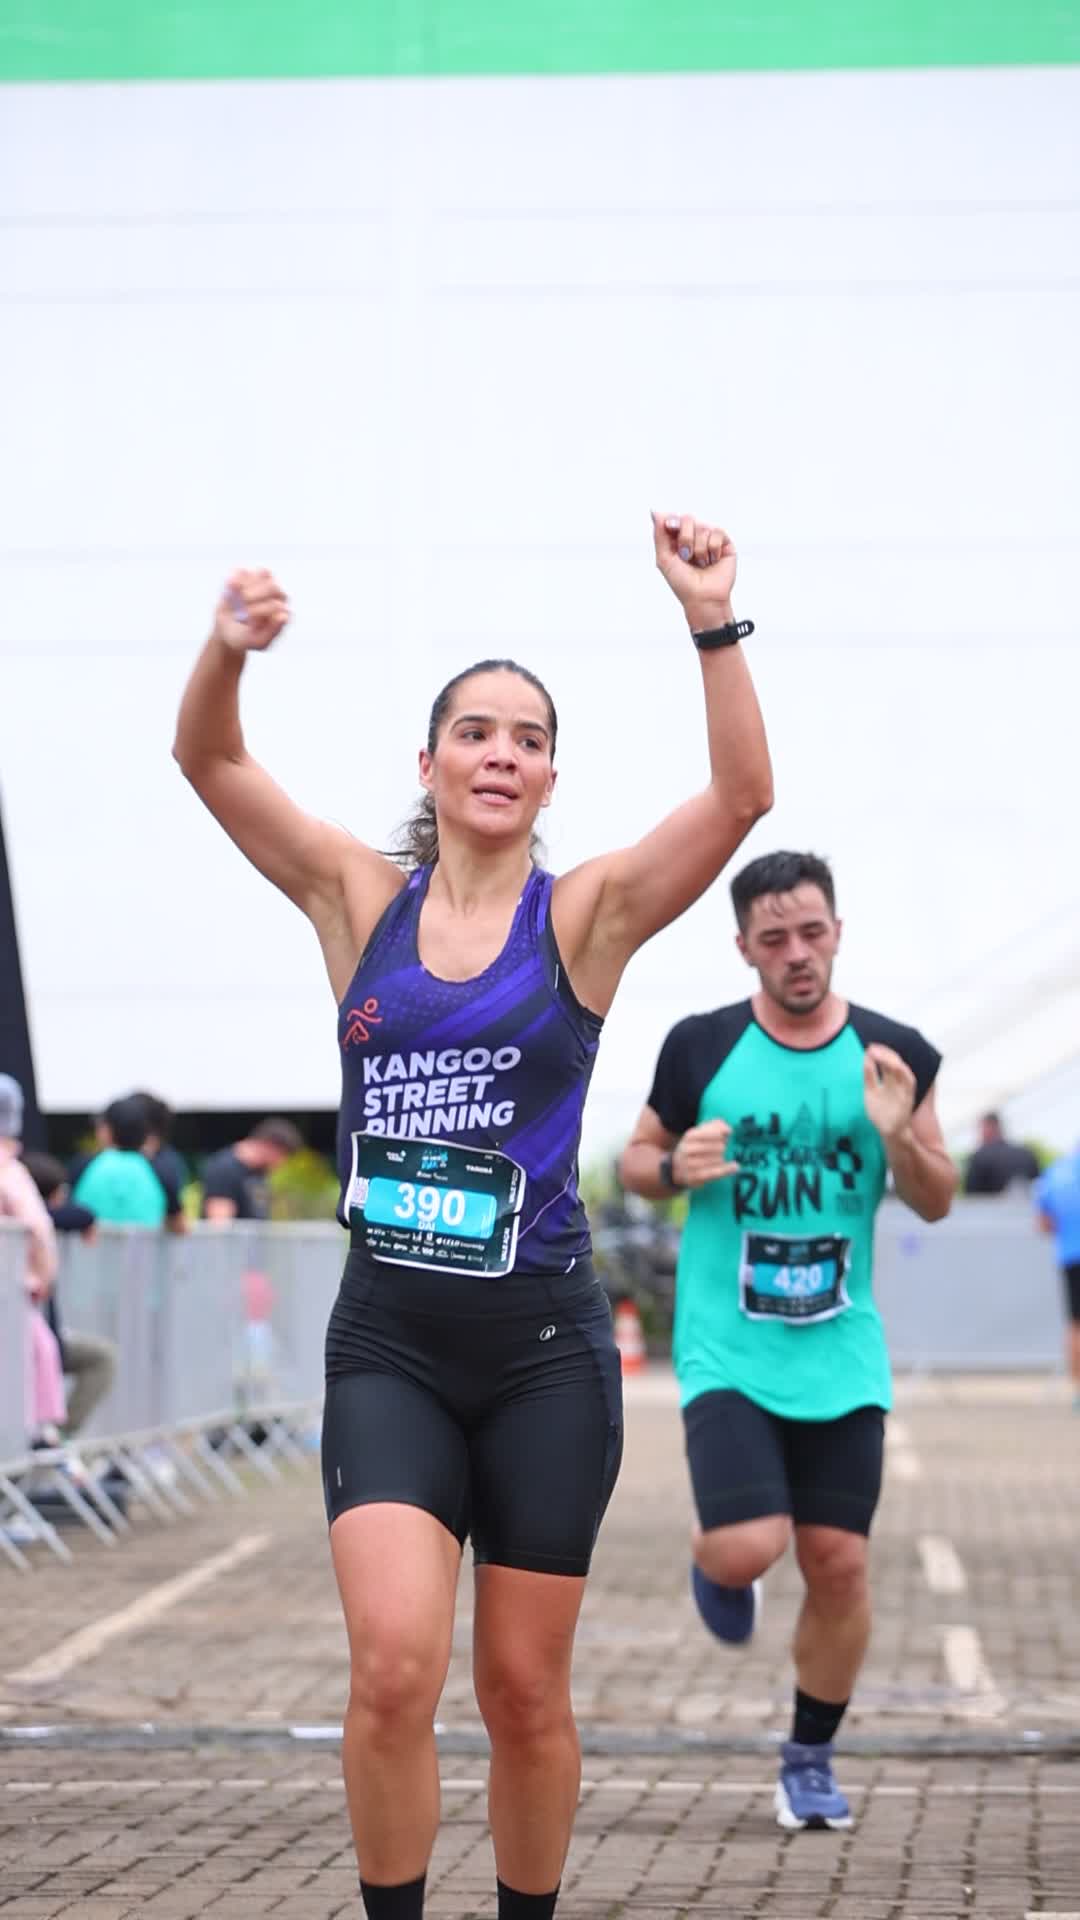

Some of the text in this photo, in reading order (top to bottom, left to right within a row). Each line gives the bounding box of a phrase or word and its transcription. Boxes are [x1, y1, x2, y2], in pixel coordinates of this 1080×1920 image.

[363, 1046, 521, 1085] KANGOO
[363, 1074, 495, 1117] STREET
[366, 1100, 516, 1138] RUNNING
[394, 1182, 466, 1226] 390
[733, 1169, 822, 1224] RUN
[773, 1264, 823, 1290] 420
